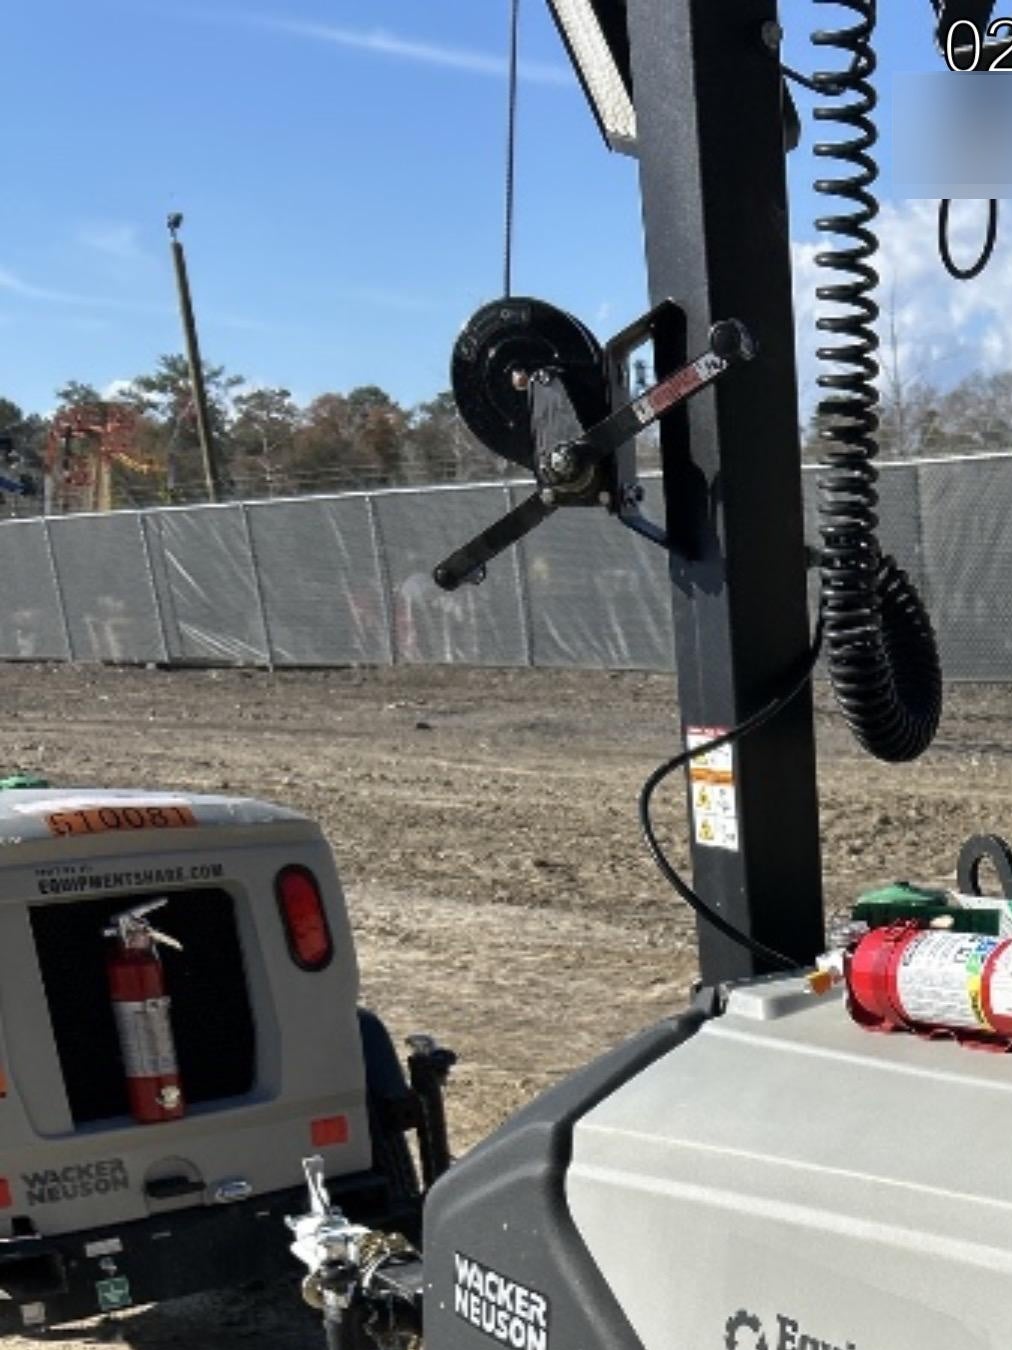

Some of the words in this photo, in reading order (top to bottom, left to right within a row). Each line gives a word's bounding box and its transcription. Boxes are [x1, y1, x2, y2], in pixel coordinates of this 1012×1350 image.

[38, 863, 224, 895] EQUIPMENTSHARE.COM
[20, 1158, 127, 1188] WACKER
[26, 1173, 129, 1206] NEUSON
[455, 1253, 547, 1328] WACKER
